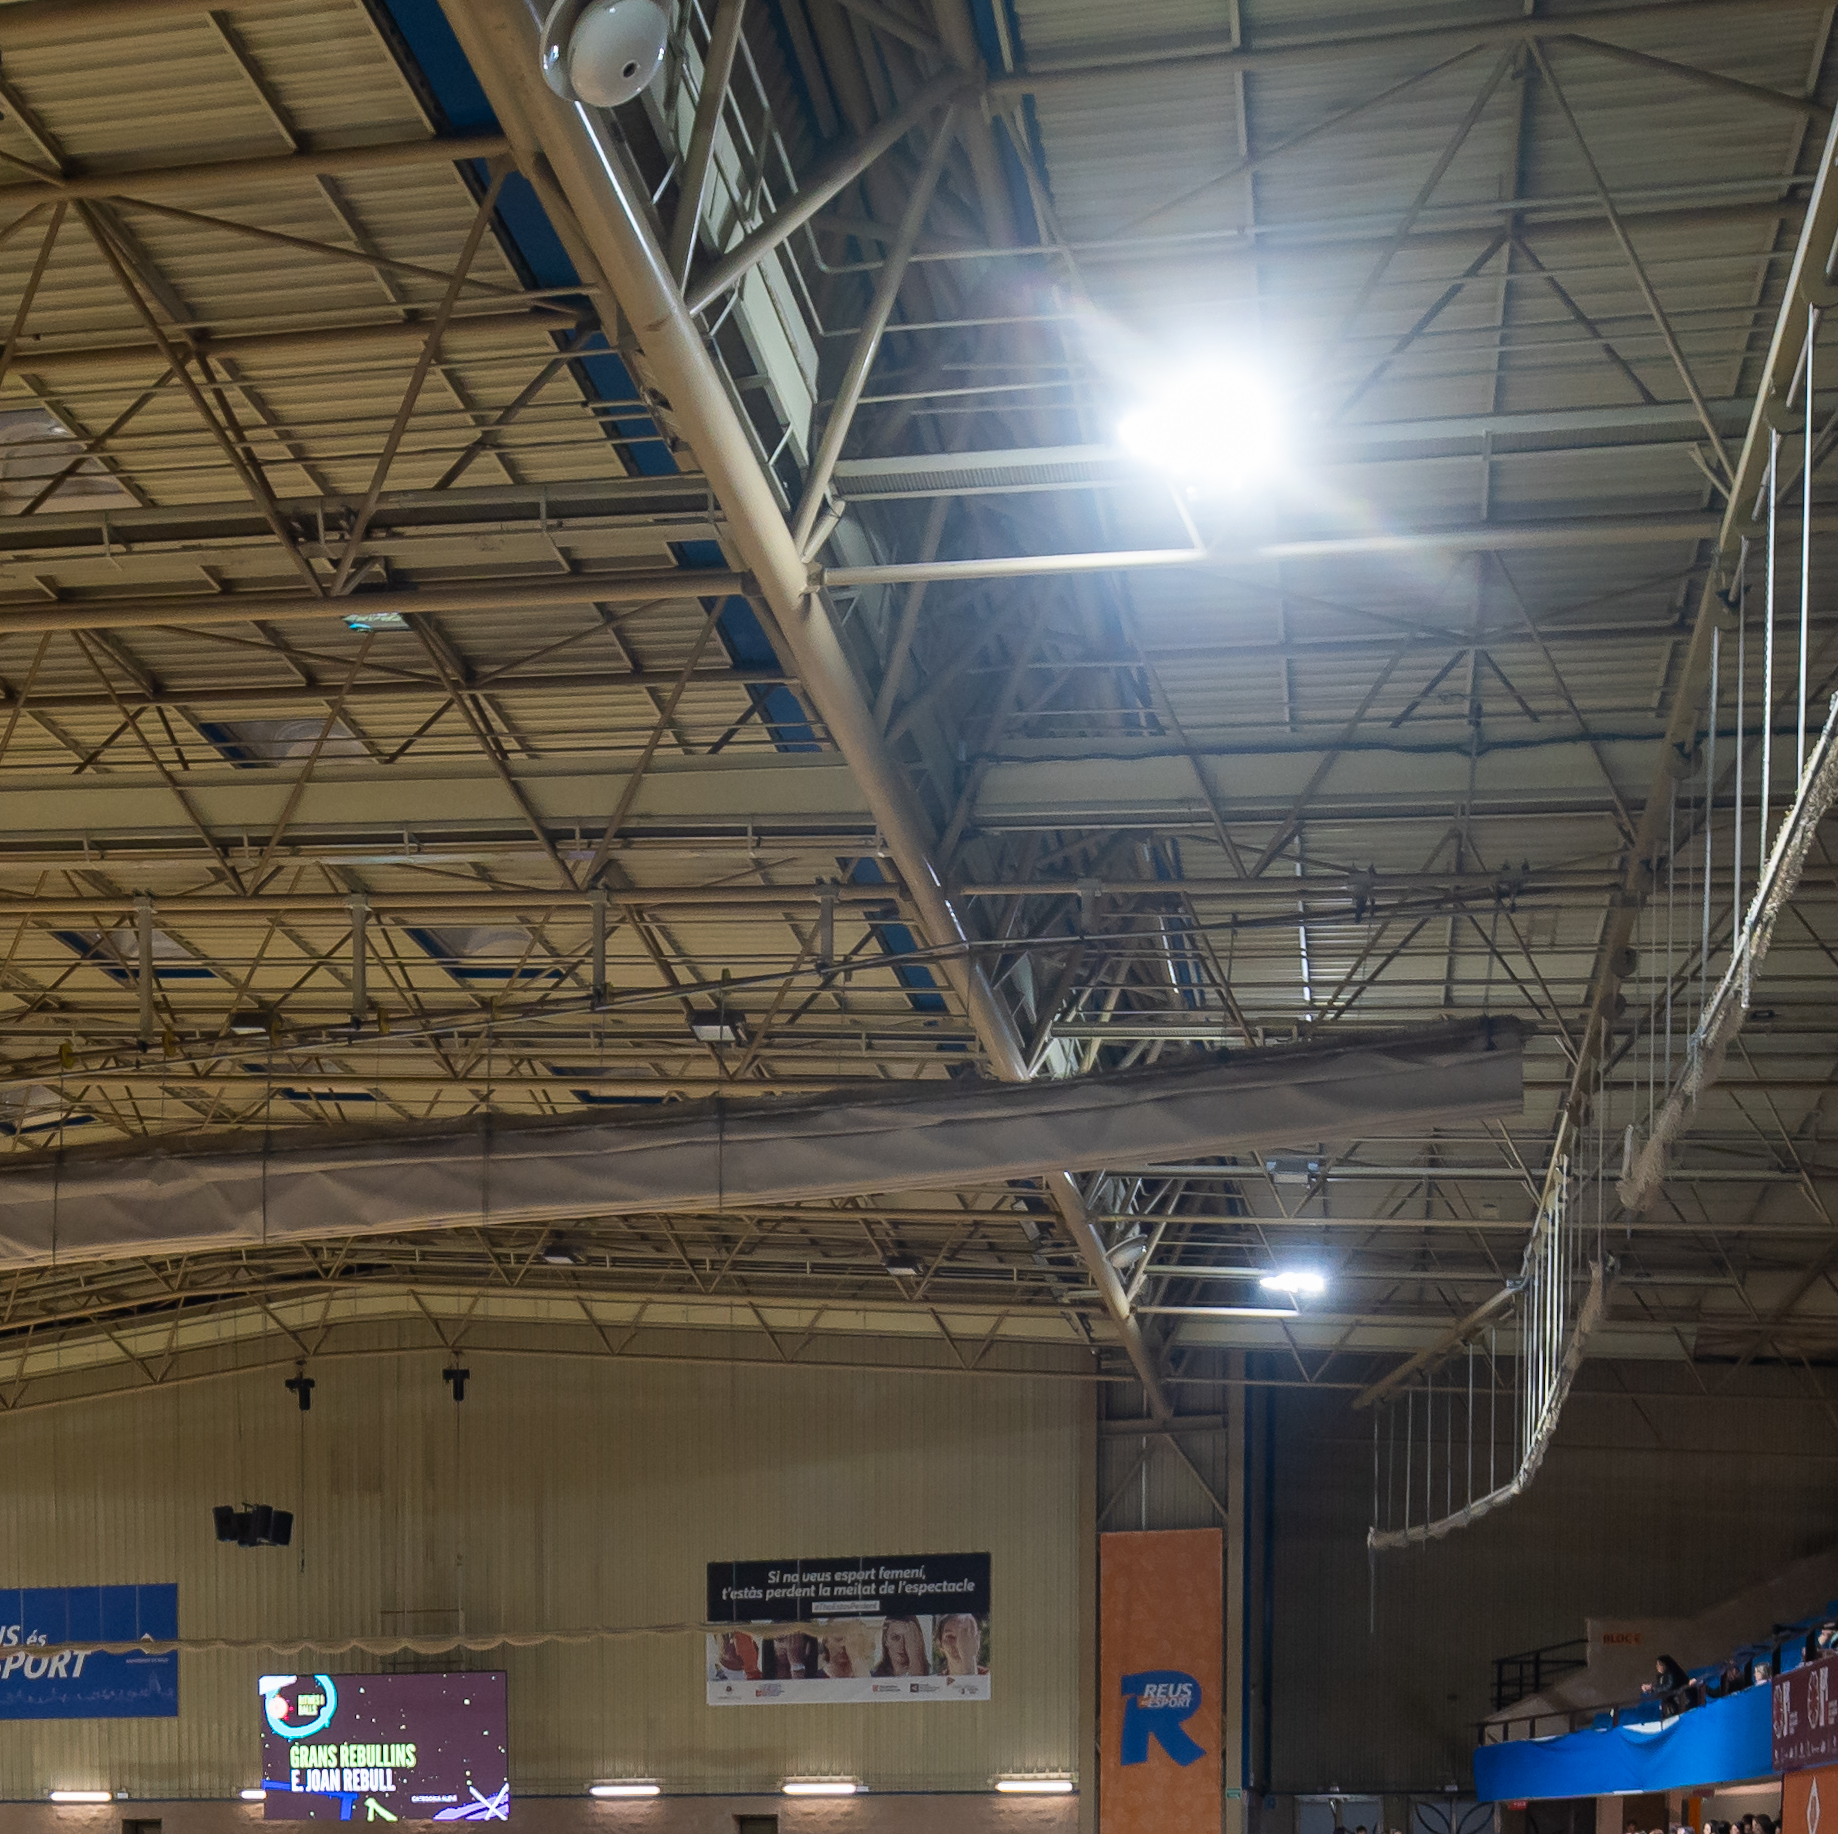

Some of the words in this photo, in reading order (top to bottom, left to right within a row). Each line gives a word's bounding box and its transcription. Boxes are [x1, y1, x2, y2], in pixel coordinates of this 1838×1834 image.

[768, 1570, 780, 1583] Si
[783, 1572, 799, 1583] no
[802, 1571, 831, 1582] veus
[834, 1568, 876, 1584] esport
[878, 1565, 926, 1580] femení,
[722, 1586, 763, 1600] t'estàs
[766, 1584, 816, 1601] perdent
[818, 1583, 831, 1596] la
[833, 1581, 876, 1596] meitat
[879, 1580, 895, 1594] de
[898, 1578, 975, 1596] l'espectacle
[26, 1630, 47, 1647] és
[1143, 1683, 1193, 1698] REUS
[1148, 1697, 1192, 1709] ESPORT
[290, 1744, 337, 1768] GRANS
[340, 1743, 416, 1768] REBULLINS
[291, 1769, 304, 1792] E.
[306, 1768, 340, 1792] JOAN
[343, 1768, 396, 1792] REBULL
